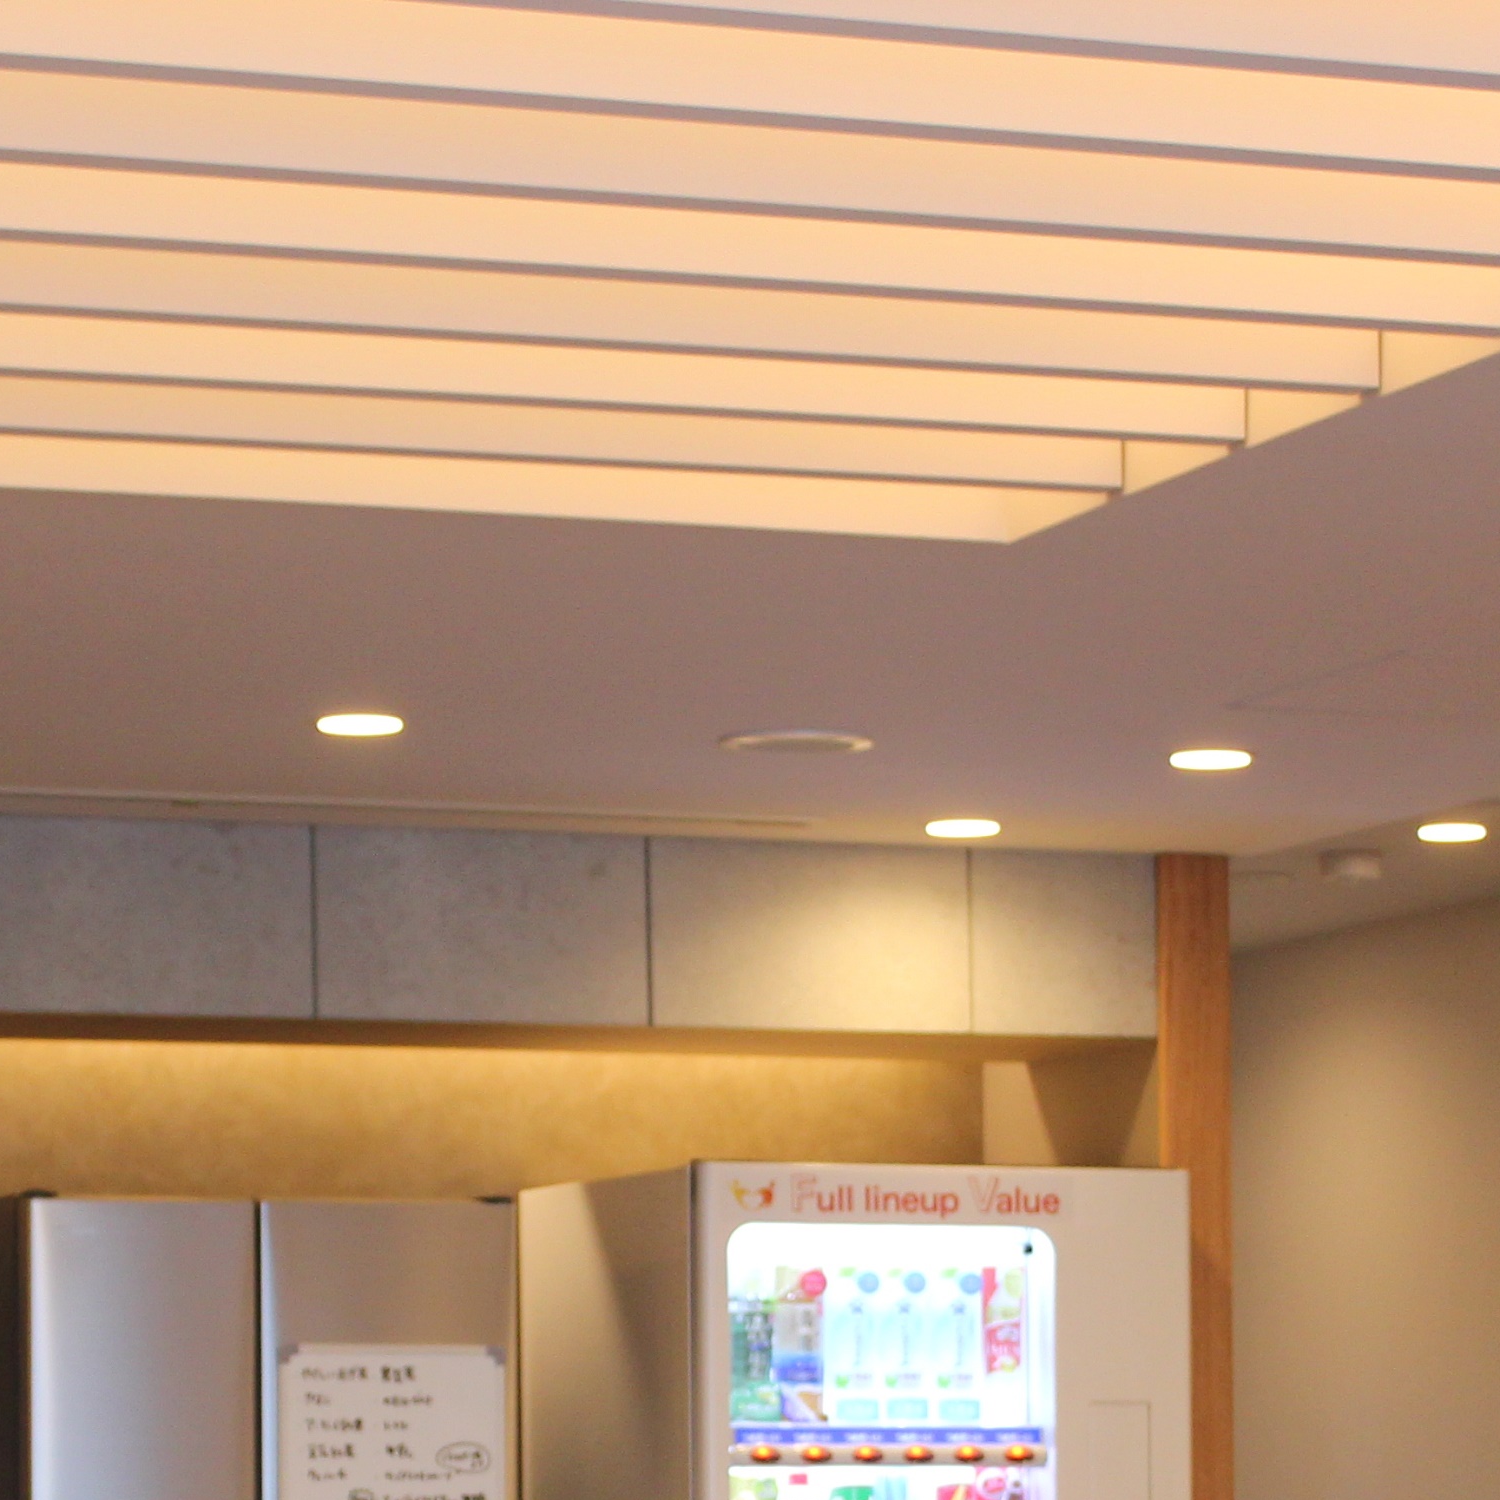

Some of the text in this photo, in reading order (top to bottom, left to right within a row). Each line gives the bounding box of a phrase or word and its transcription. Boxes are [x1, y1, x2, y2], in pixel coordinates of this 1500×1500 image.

[790, 1174, 1060, 1218] Full lineup Value
